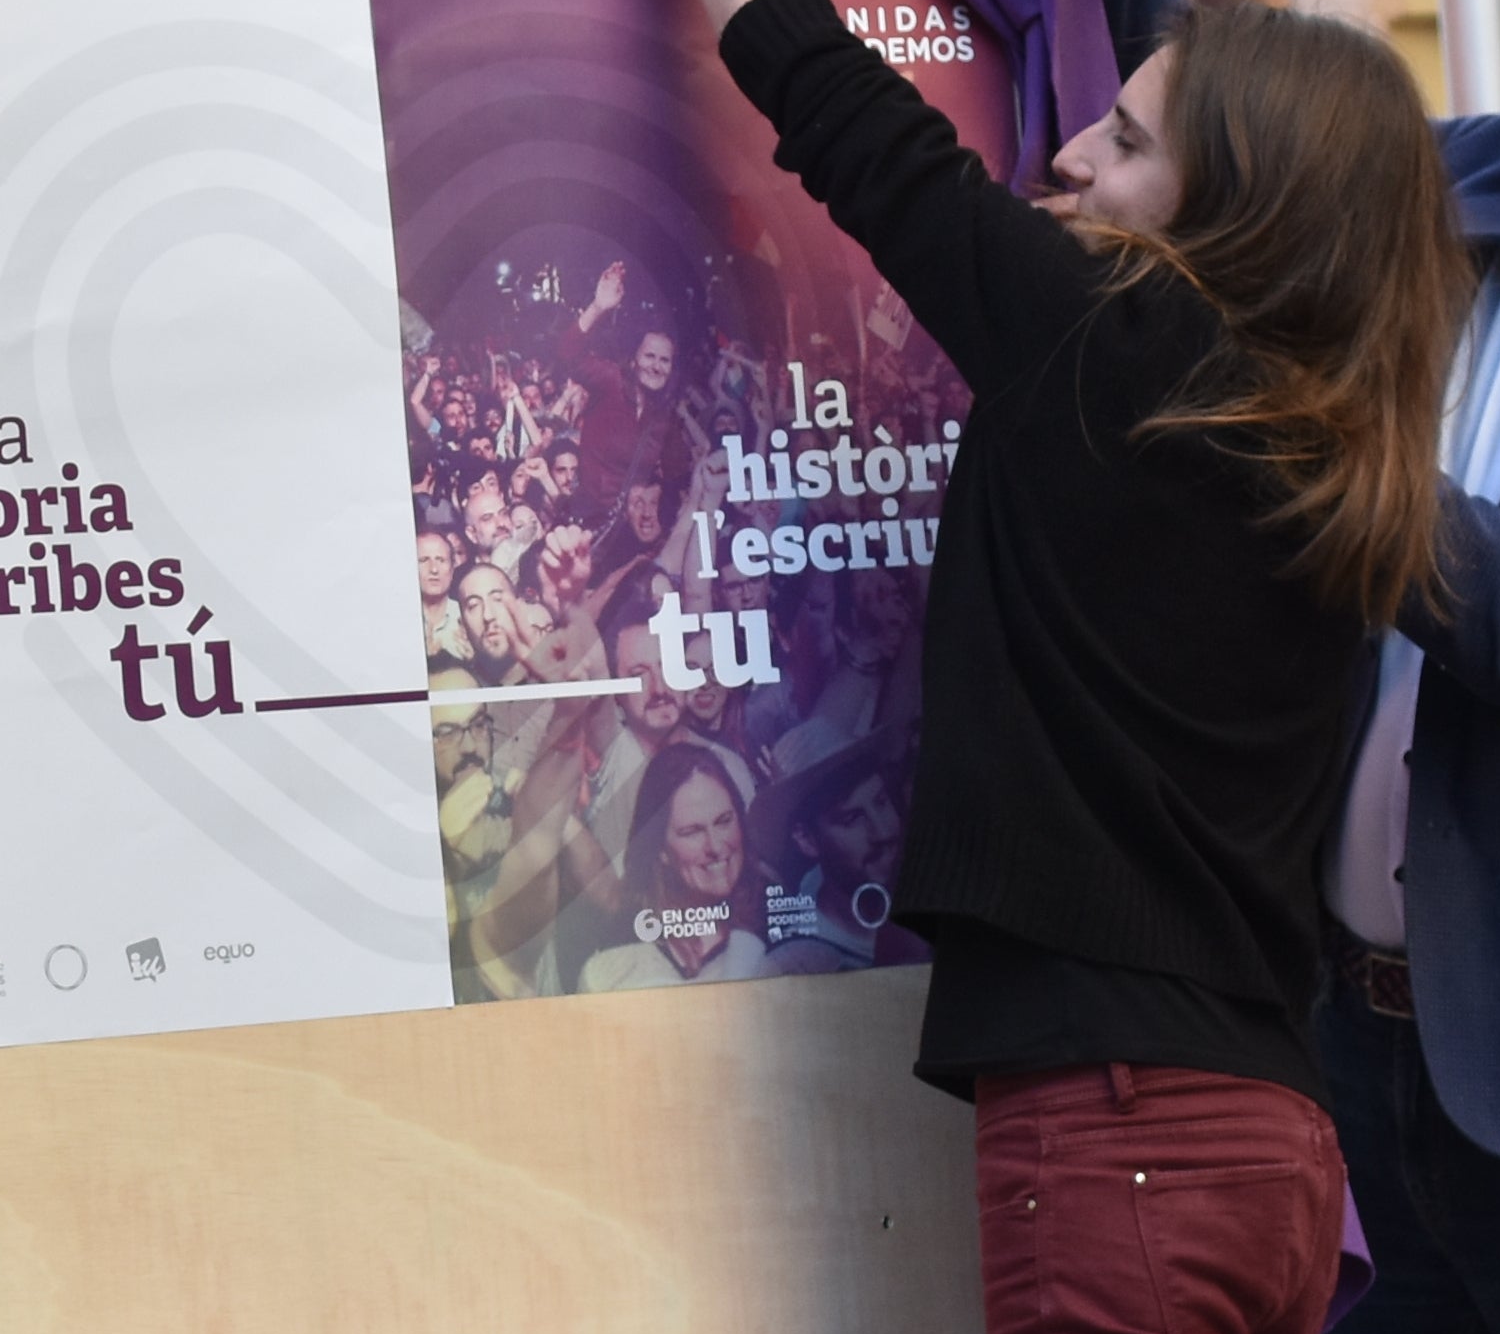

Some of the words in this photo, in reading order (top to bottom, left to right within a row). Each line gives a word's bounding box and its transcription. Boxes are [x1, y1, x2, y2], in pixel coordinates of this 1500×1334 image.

[846, 5, 972, 35] NIDAS
[788, 363, 853, 430] la
[721, 419, 962, 503] històri
[691, 497, 941, 581] l'escriu
[110, 604, 245, 723] tú
[648, 590, 782, 694] tu
[662, 908, 683, 923] EN
[684, 901, 730, 922] COMÚ
[766, 885, 784, 897] en
[662, 921, 717, 939] PODEM
